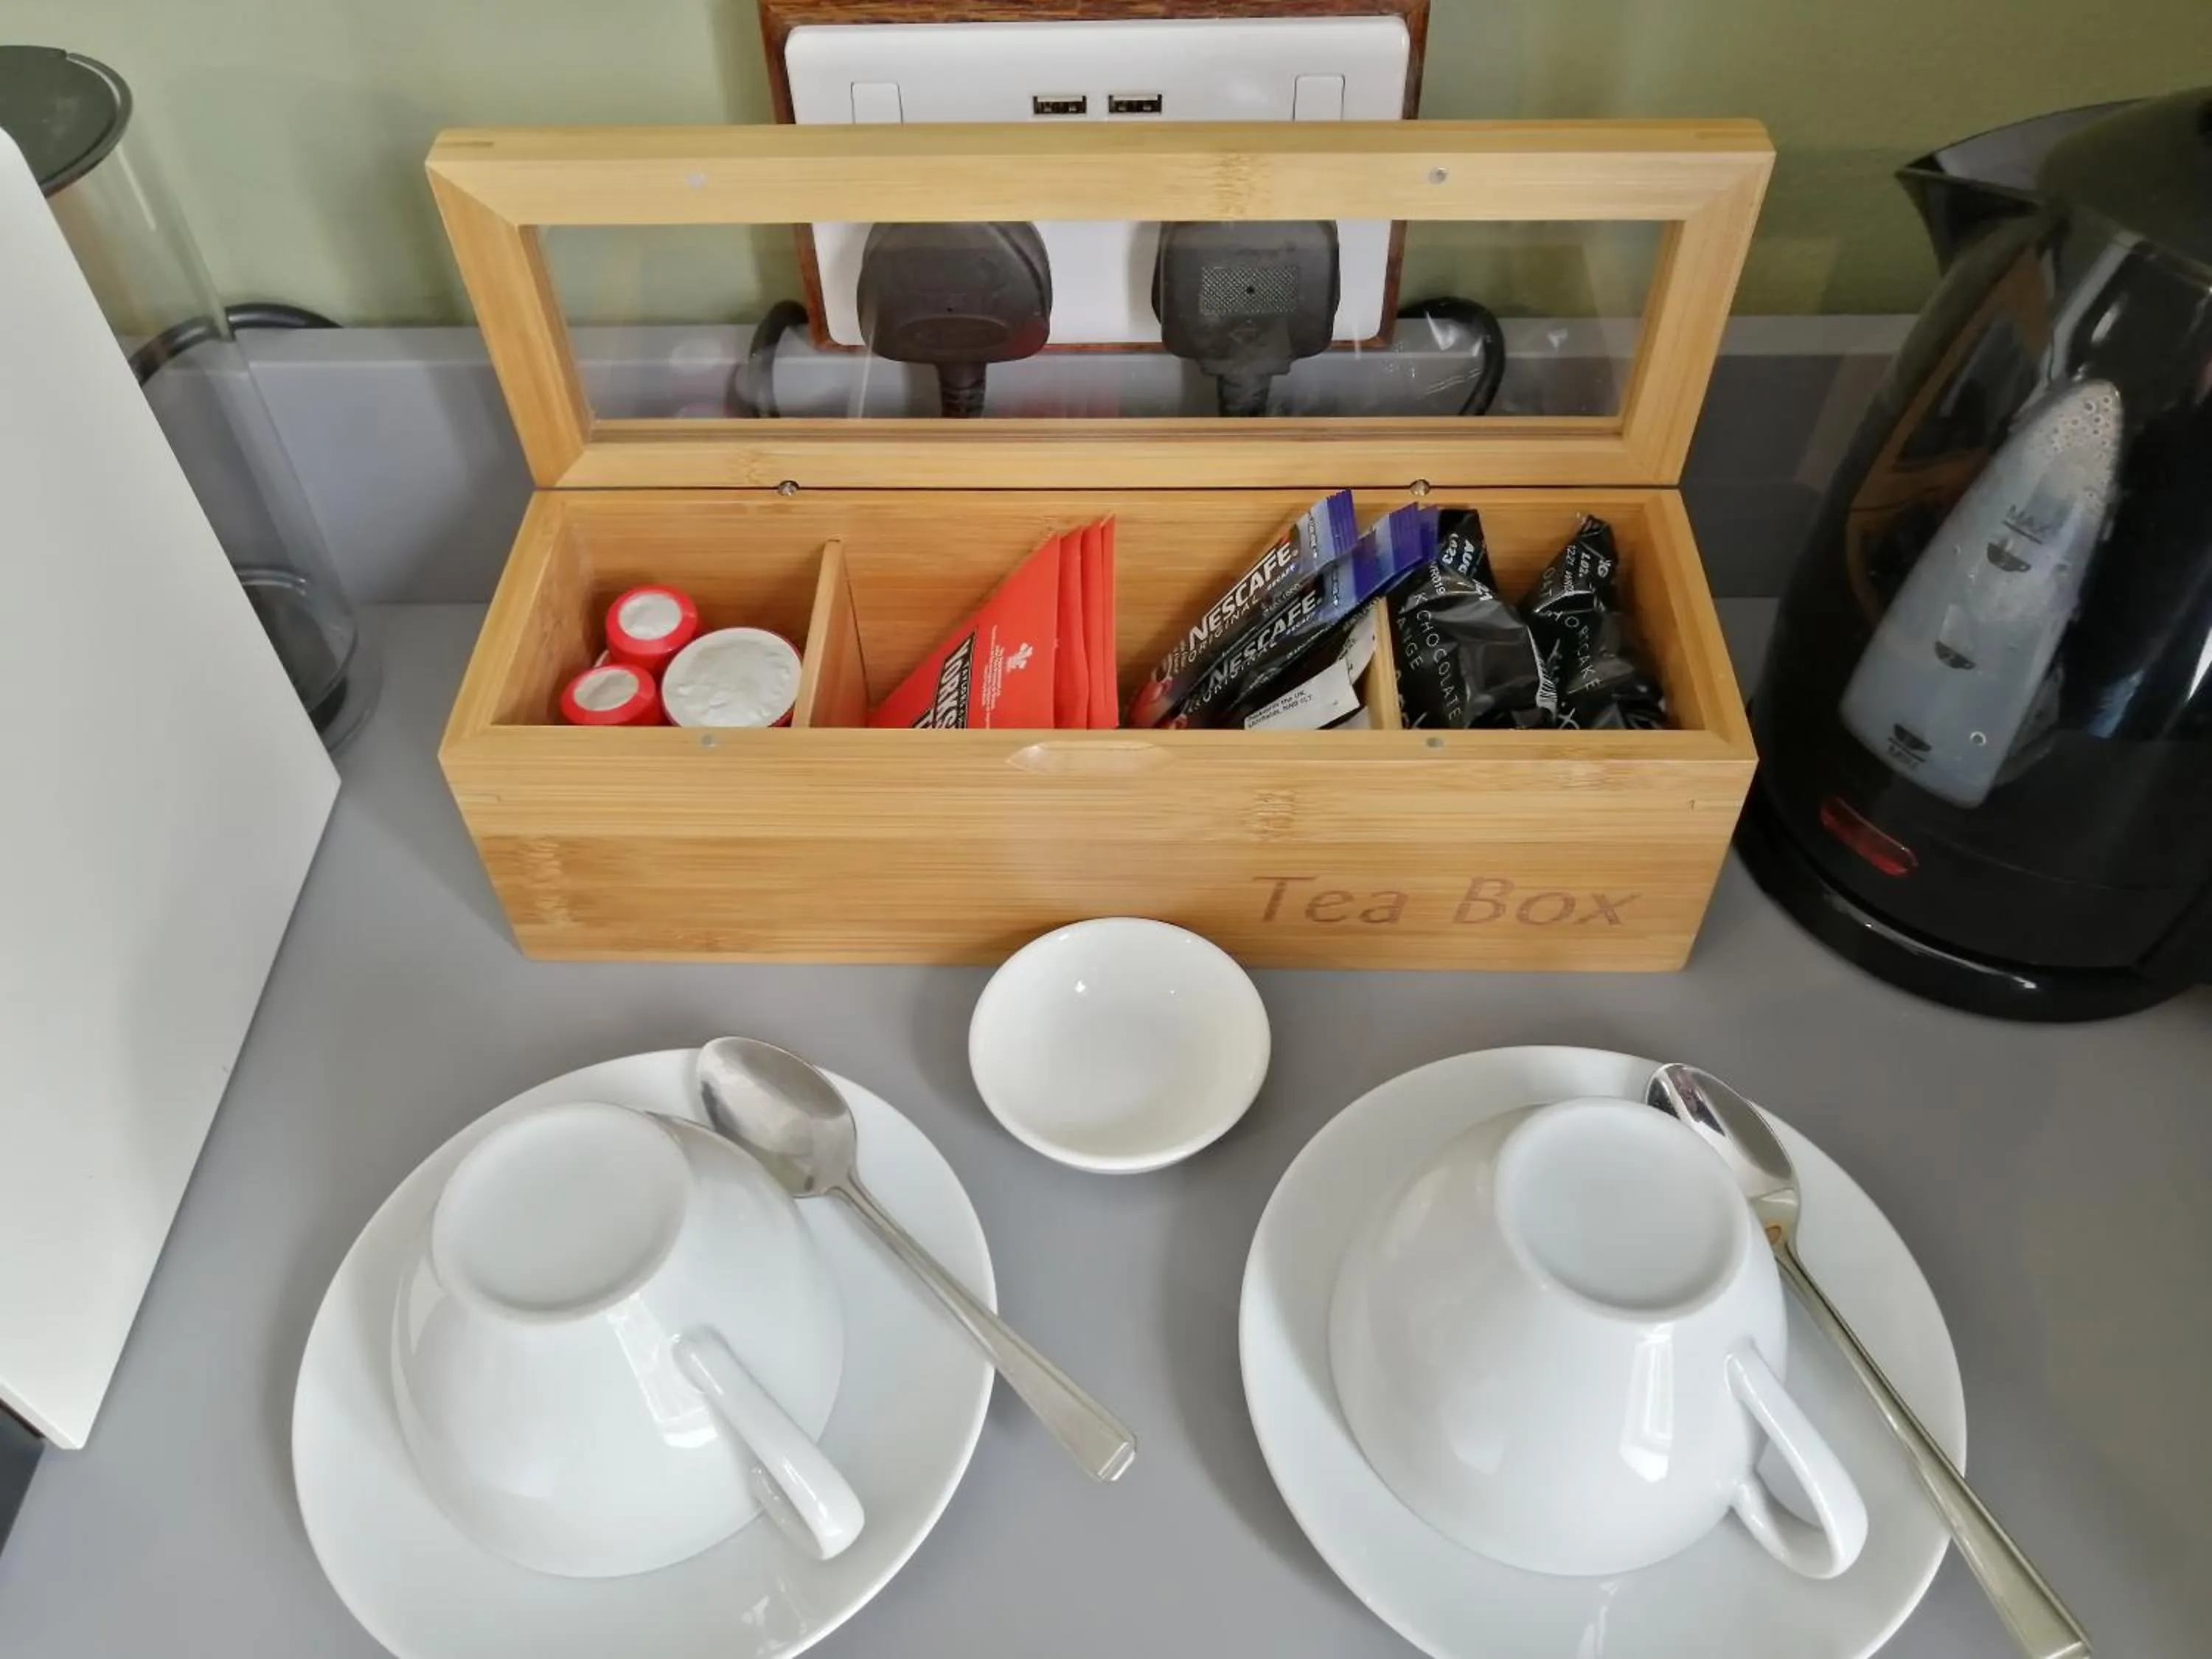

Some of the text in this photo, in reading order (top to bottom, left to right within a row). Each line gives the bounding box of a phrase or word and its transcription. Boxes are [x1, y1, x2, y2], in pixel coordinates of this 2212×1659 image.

[1188, 594, 1262, 663] ORIGINAL
[1416, 610, 1462, 720] CHOCOLATE
[934, 636, 971, 728] YORKS
[1253, 876, 1642, 927] Tea Box
